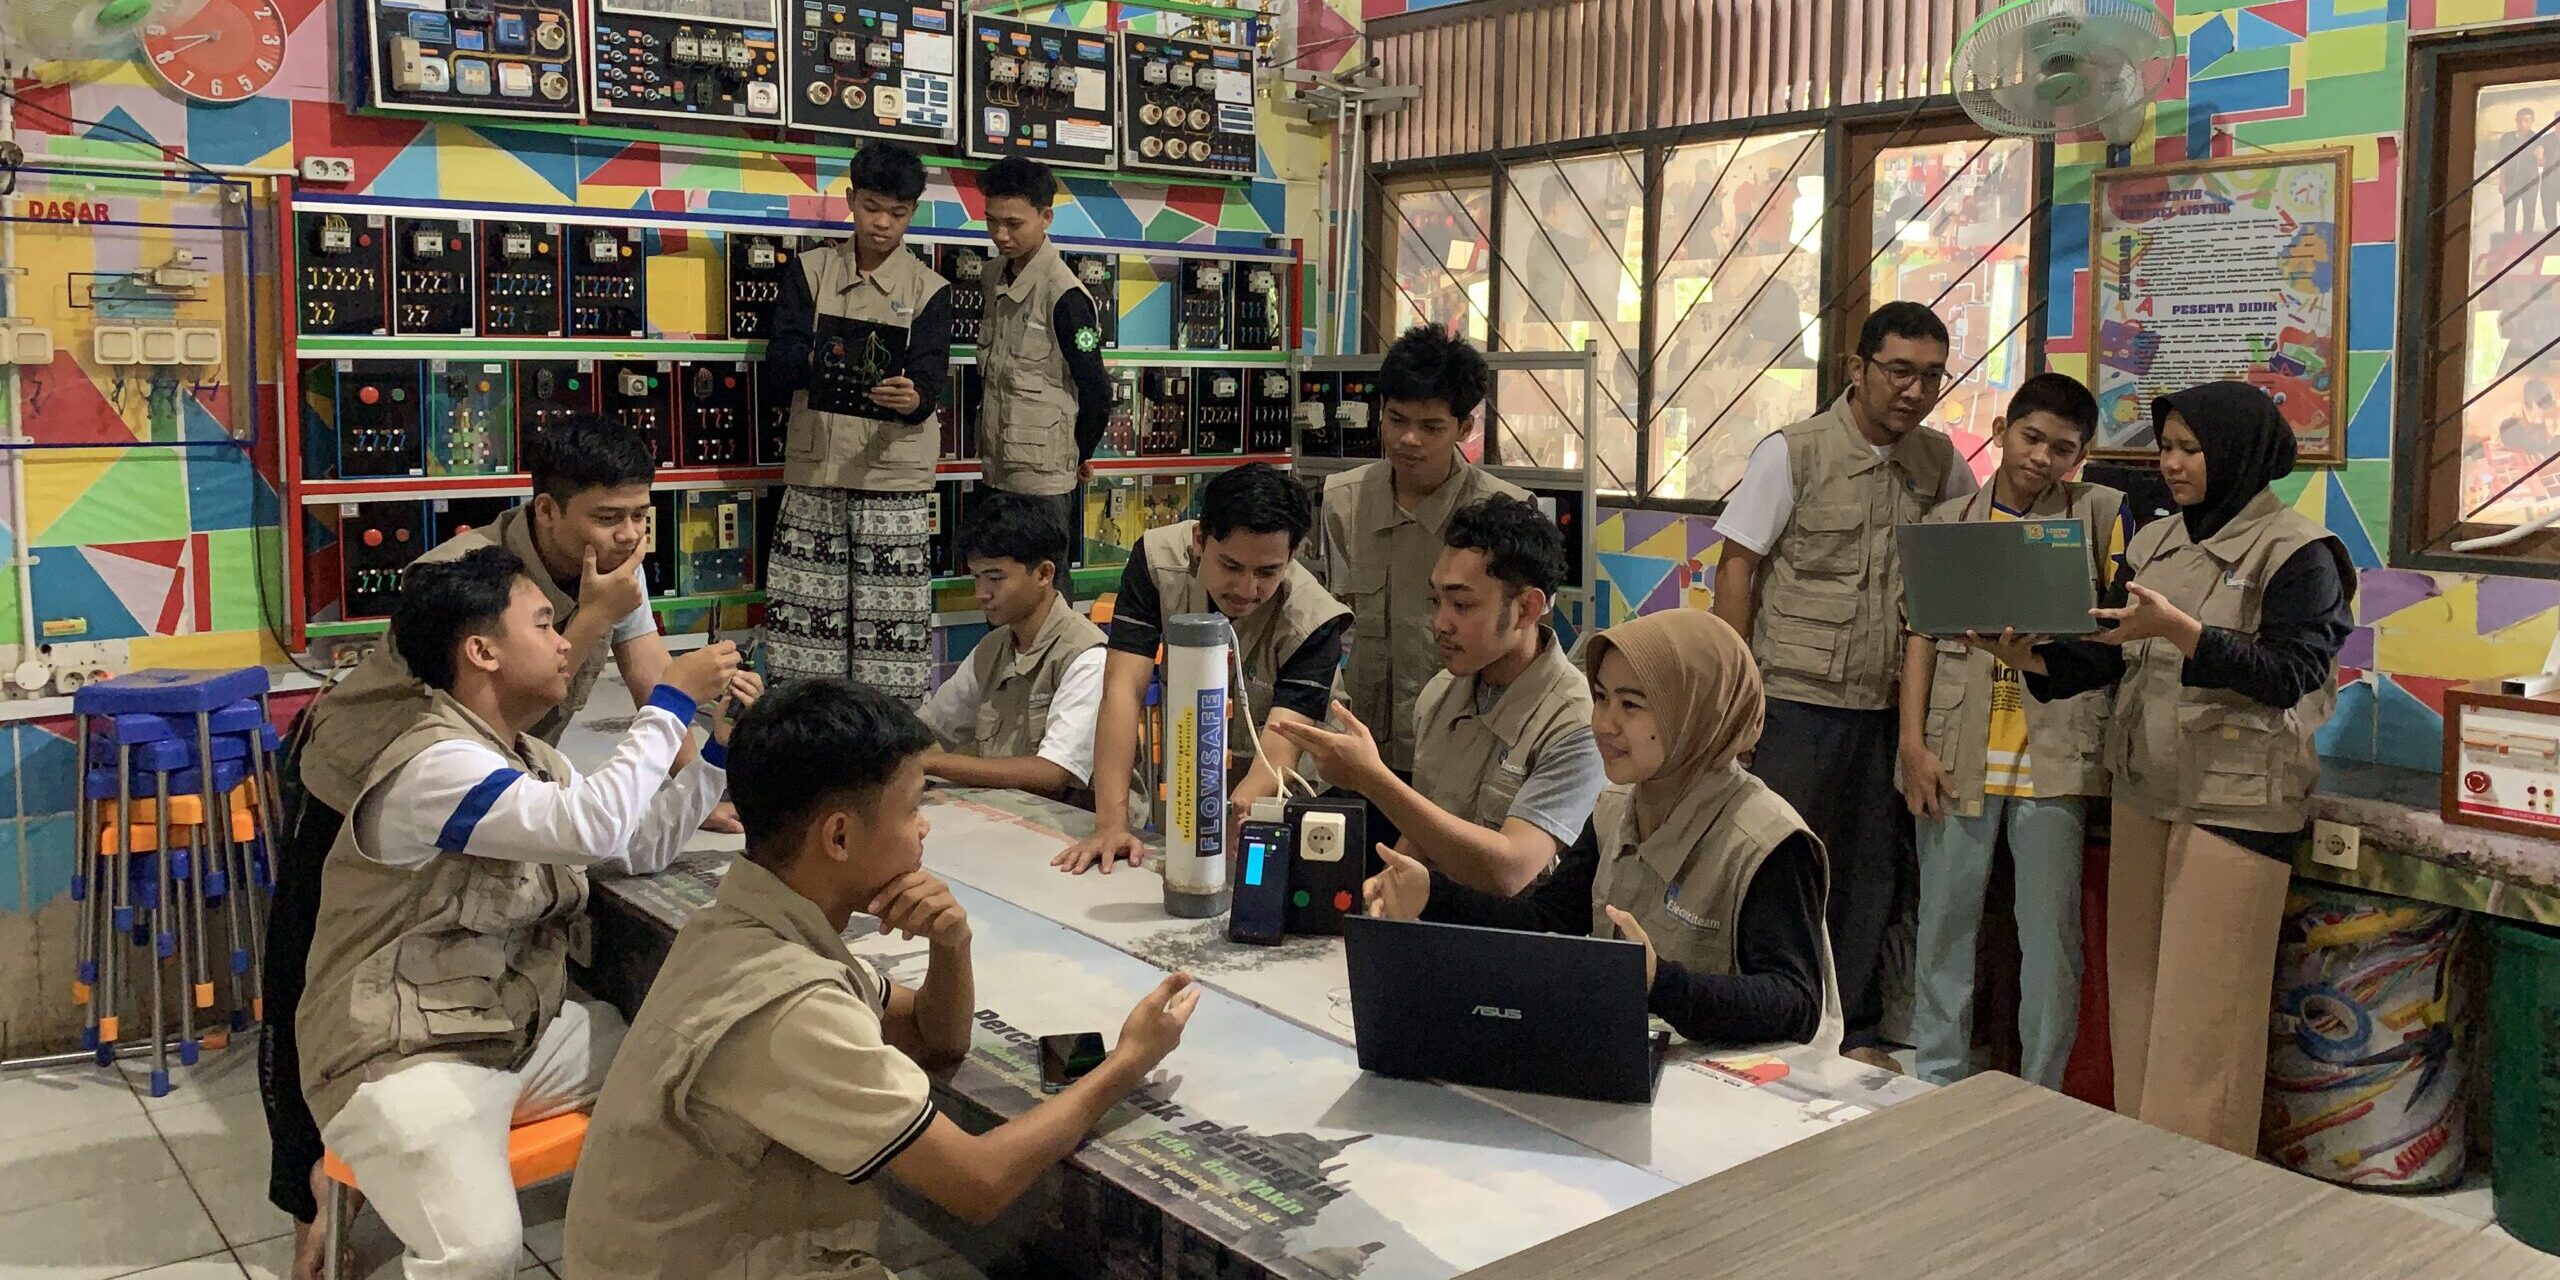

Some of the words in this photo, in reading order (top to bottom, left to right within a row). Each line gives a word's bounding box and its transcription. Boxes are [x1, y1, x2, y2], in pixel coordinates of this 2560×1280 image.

[254, 6, 272, 20] 2
[262, 34, 281, 46] 3
[155, 50, 175, 65] 8
[256, 57, 274, 73] 4
[180, 69, 195, 87] 7
[237, 74, 254, 92] 5
[211, 78, 223, 96] 6
[28, 200, 111, 223] DASAR
[2172, 304, 2234, 315] PESERTA
[2239, 302, 2278, 313] DIDIK
[1200, 693, 1221, 852] FLOWSAFE
[1472, 1005, 1522, 1020] ASUS
[1200, 1157, 1241, 1182] dan
[1244, 1177, 1305, 1215] YAkin
